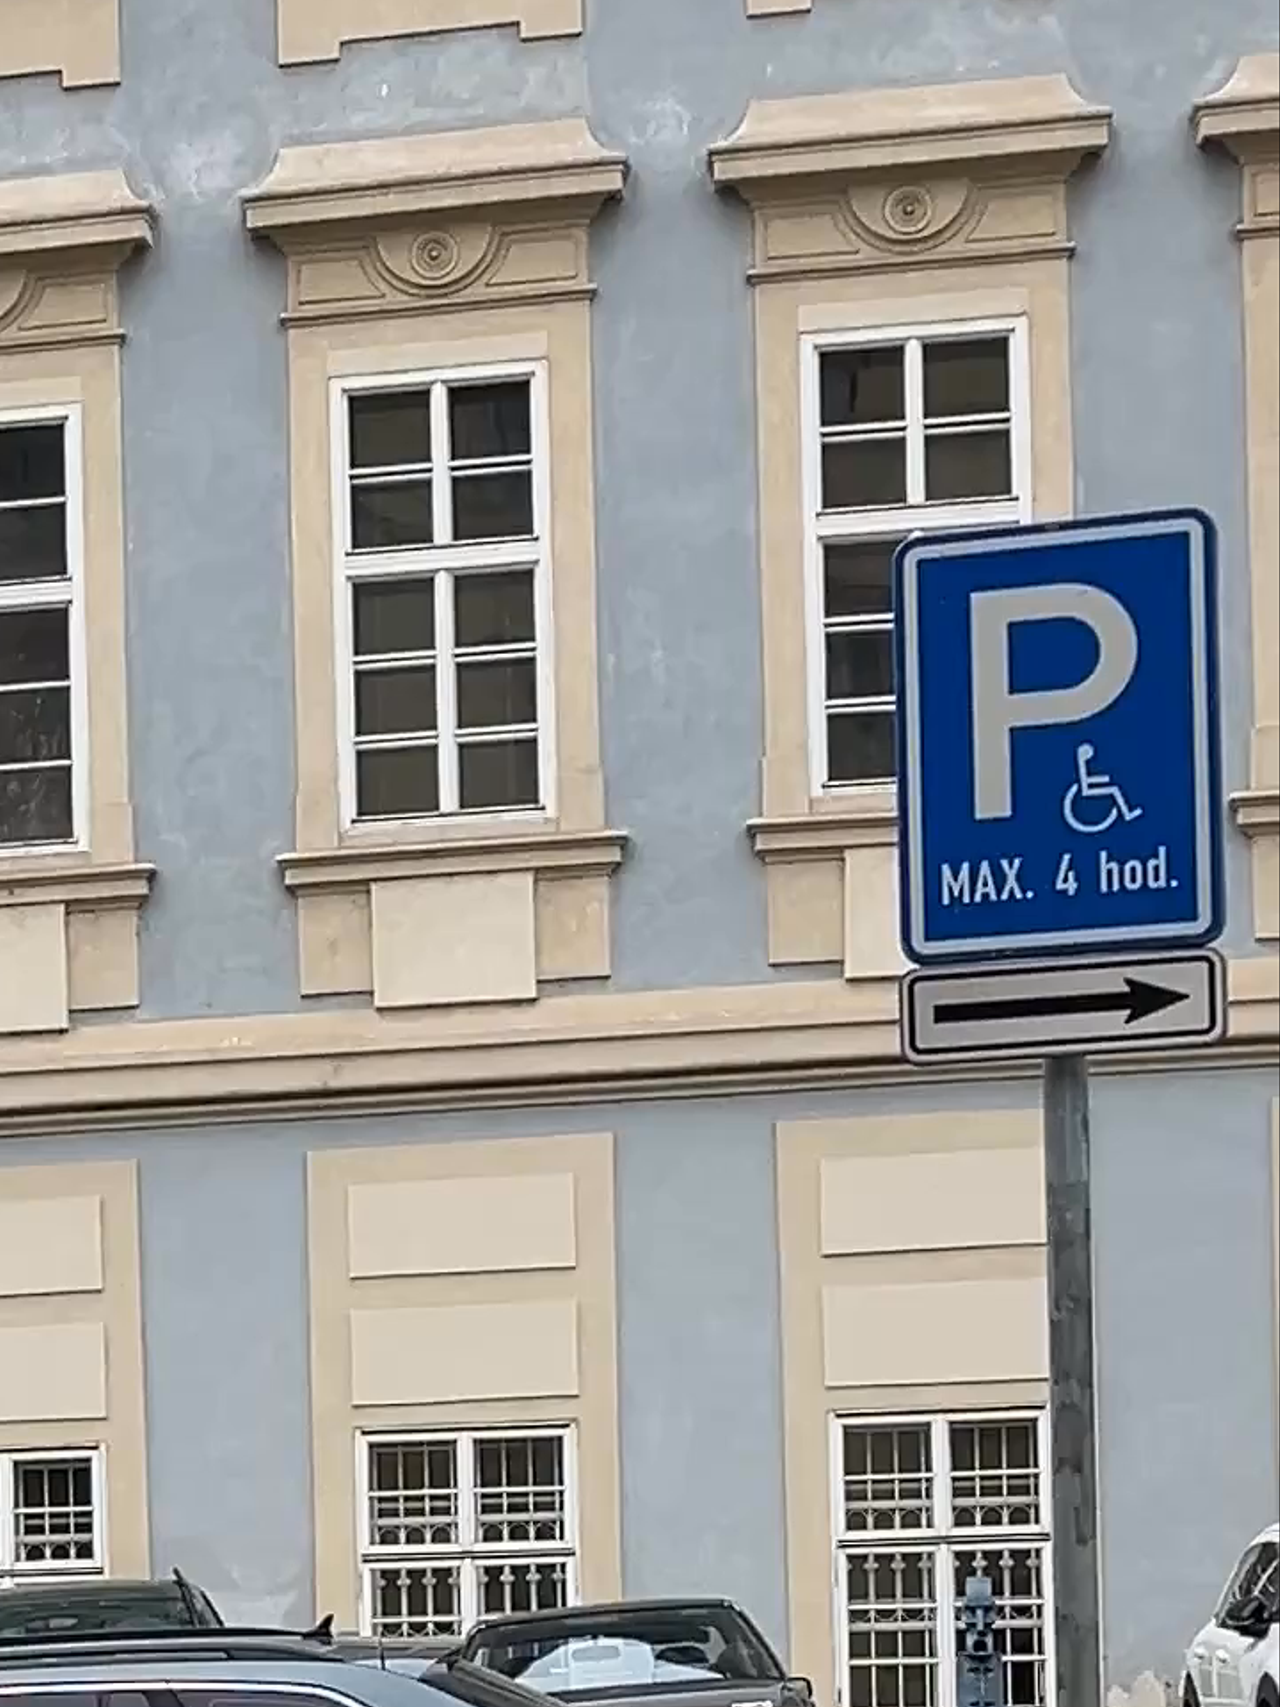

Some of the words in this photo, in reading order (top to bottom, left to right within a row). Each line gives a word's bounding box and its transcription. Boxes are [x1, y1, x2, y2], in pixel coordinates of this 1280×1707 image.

[969, 582, 1139, 821] P
[940, 857, 1035, 906] MAX.
[1054, 853, 1079, 897] 4
[1099, 845, 1180, 893] hod.
